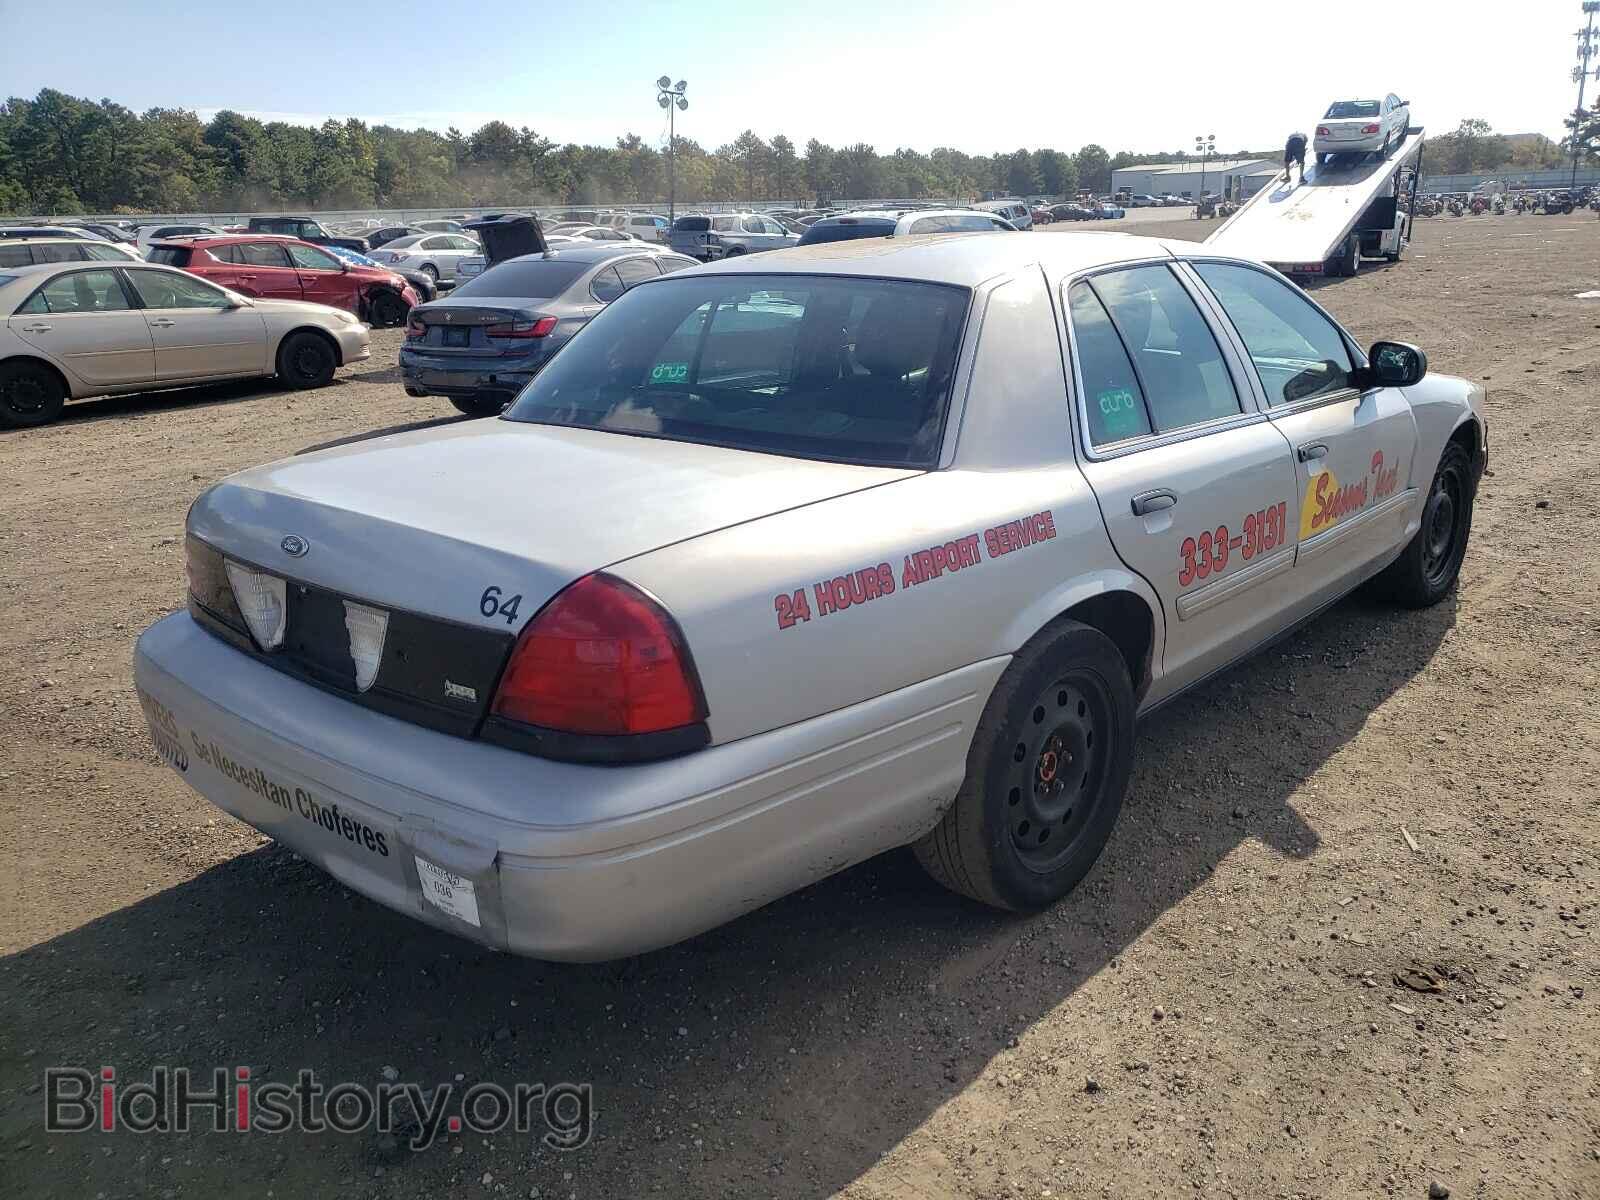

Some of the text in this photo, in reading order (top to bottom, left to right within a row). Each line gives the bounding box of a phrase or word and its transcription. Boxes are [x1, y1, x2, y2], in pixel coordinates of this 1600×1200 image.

[1099, 391, 1135, 414] curb
[774, 510, 1057, 630] 24 HOURS AIRPORT SERVICE
[1178, 501, 1288, 588] 333-3131
[479, 585, 523, 625] 64
[190, 730, 390, 858] Se Necesitan Choferes
